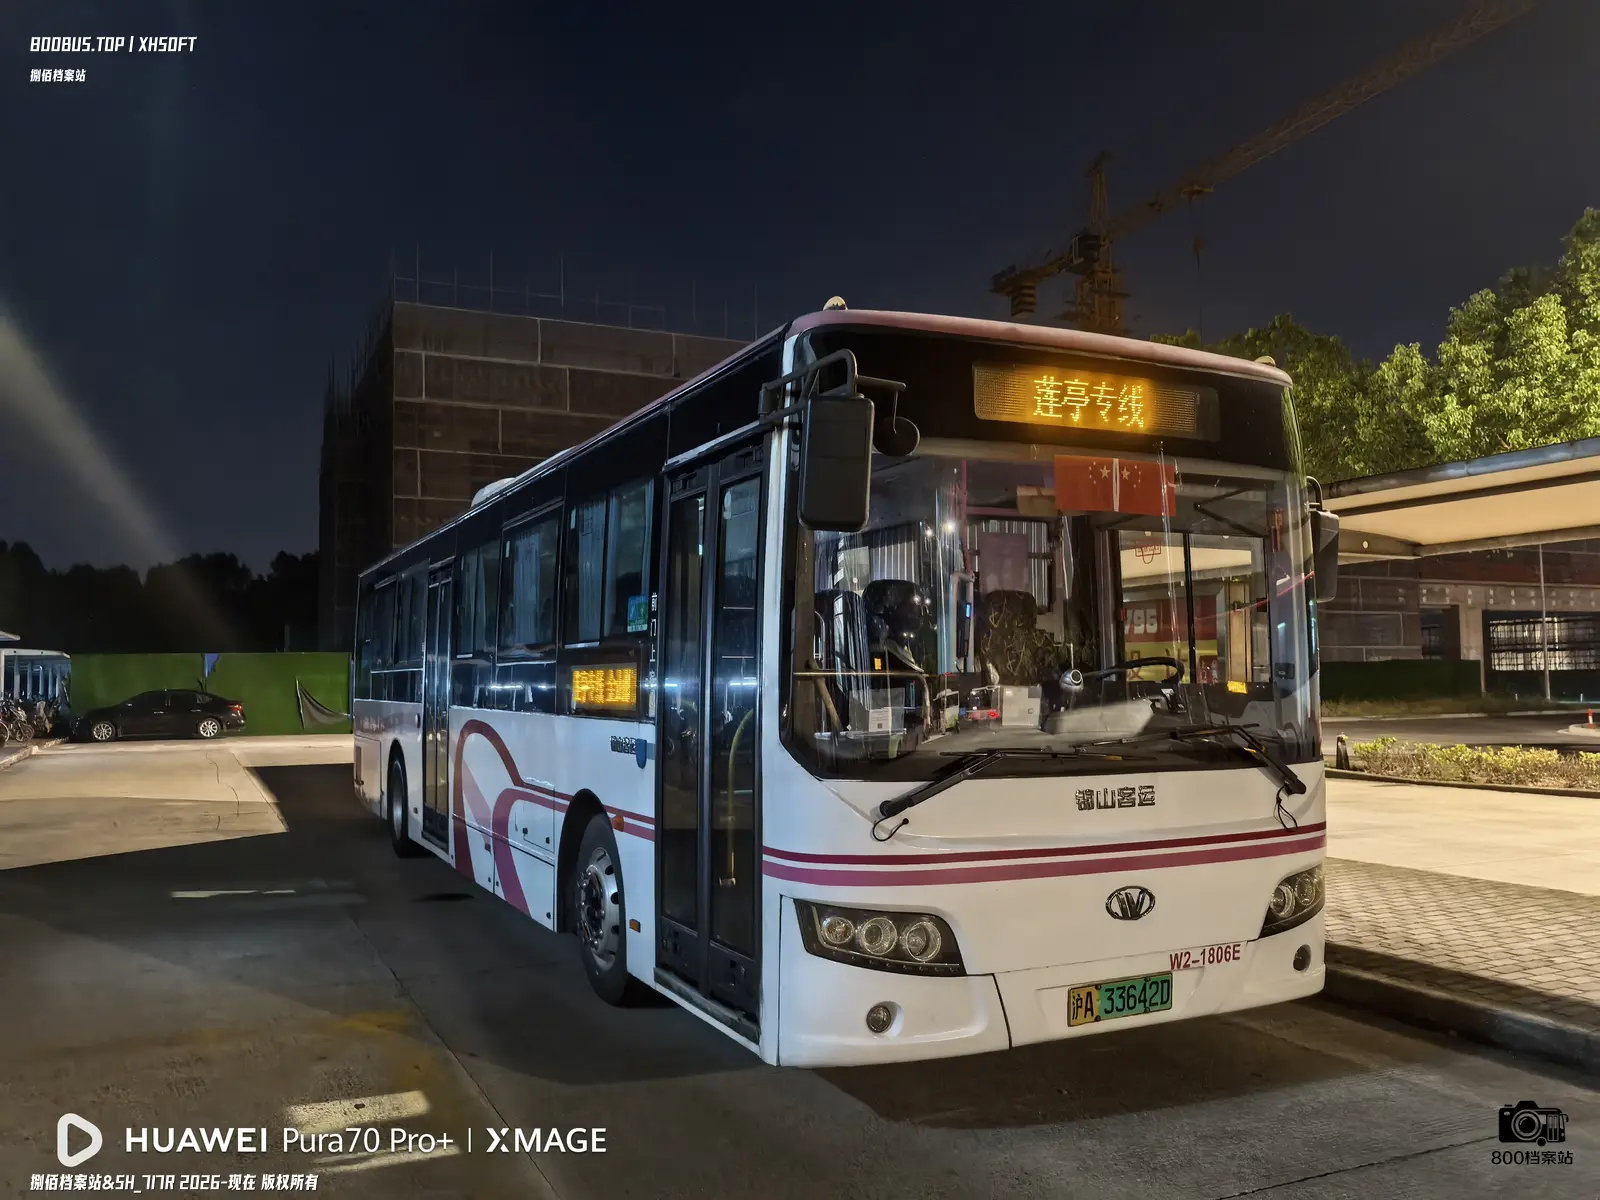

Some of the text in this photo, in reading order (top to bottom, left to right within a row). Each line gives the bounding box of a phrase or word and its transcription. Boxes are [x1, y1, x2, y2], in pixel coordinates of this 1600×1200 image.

[1033, 375, 1145, 428] 莲亭专线
[1169, 943, 1241, 971] W2-1806E
